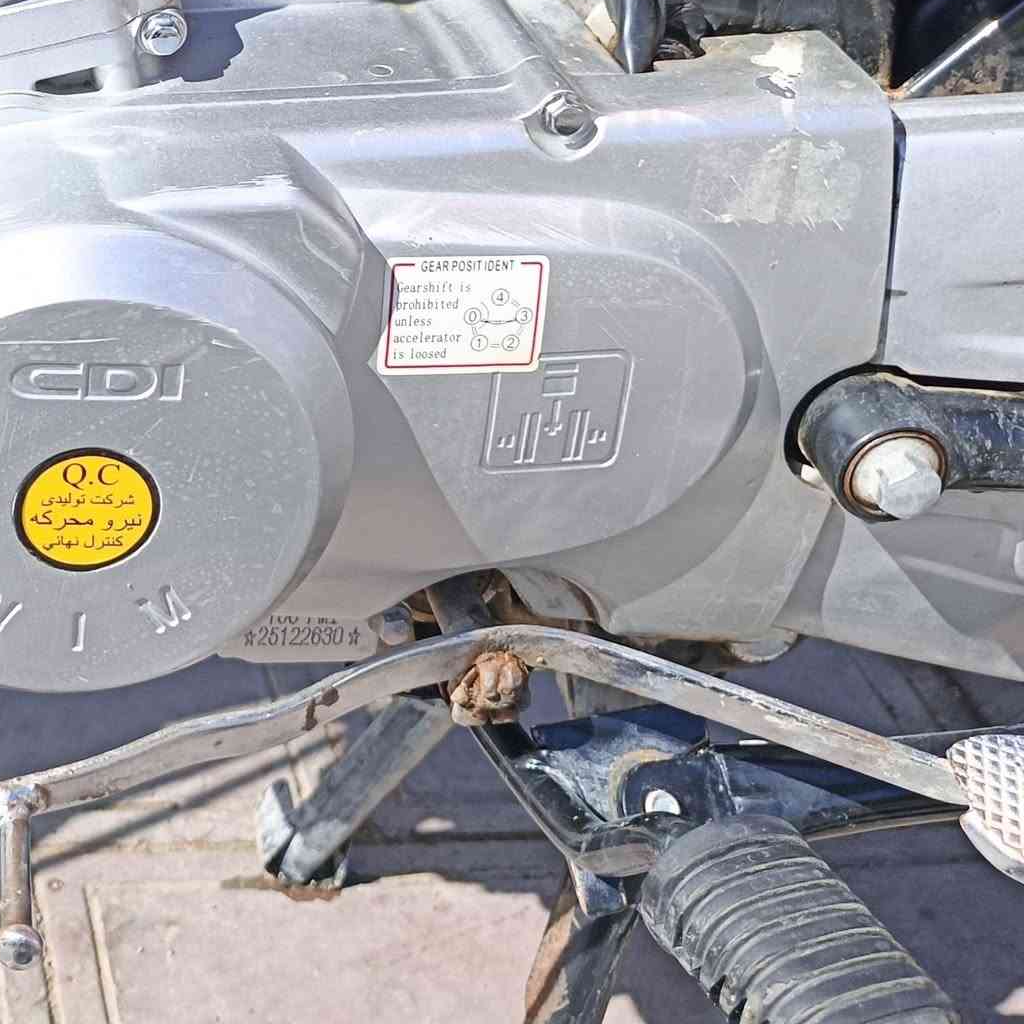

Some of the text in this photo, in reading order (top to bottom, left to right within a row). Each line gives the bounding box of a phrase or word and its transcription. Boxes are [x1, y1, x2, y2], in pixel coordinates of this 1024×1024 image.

[420, 260, 449, 272] GEAR
[397, 280, 471, 293] Gearshift is
[395, 298, 459, 312] prohibited
[394, 315, 432, 327] unless
[393, 332, 462, 344] accelerator
[393, 347, 447, 360] is loosed
[10, 361, 186, 402] CDI
[62, 462, 121, 490] Q.C
[41, 492, 136, 509] شرکت تولیدی
[29, 510, 142, 531] نیرو محرکه
[83, 535, 124, 550] کنترل
